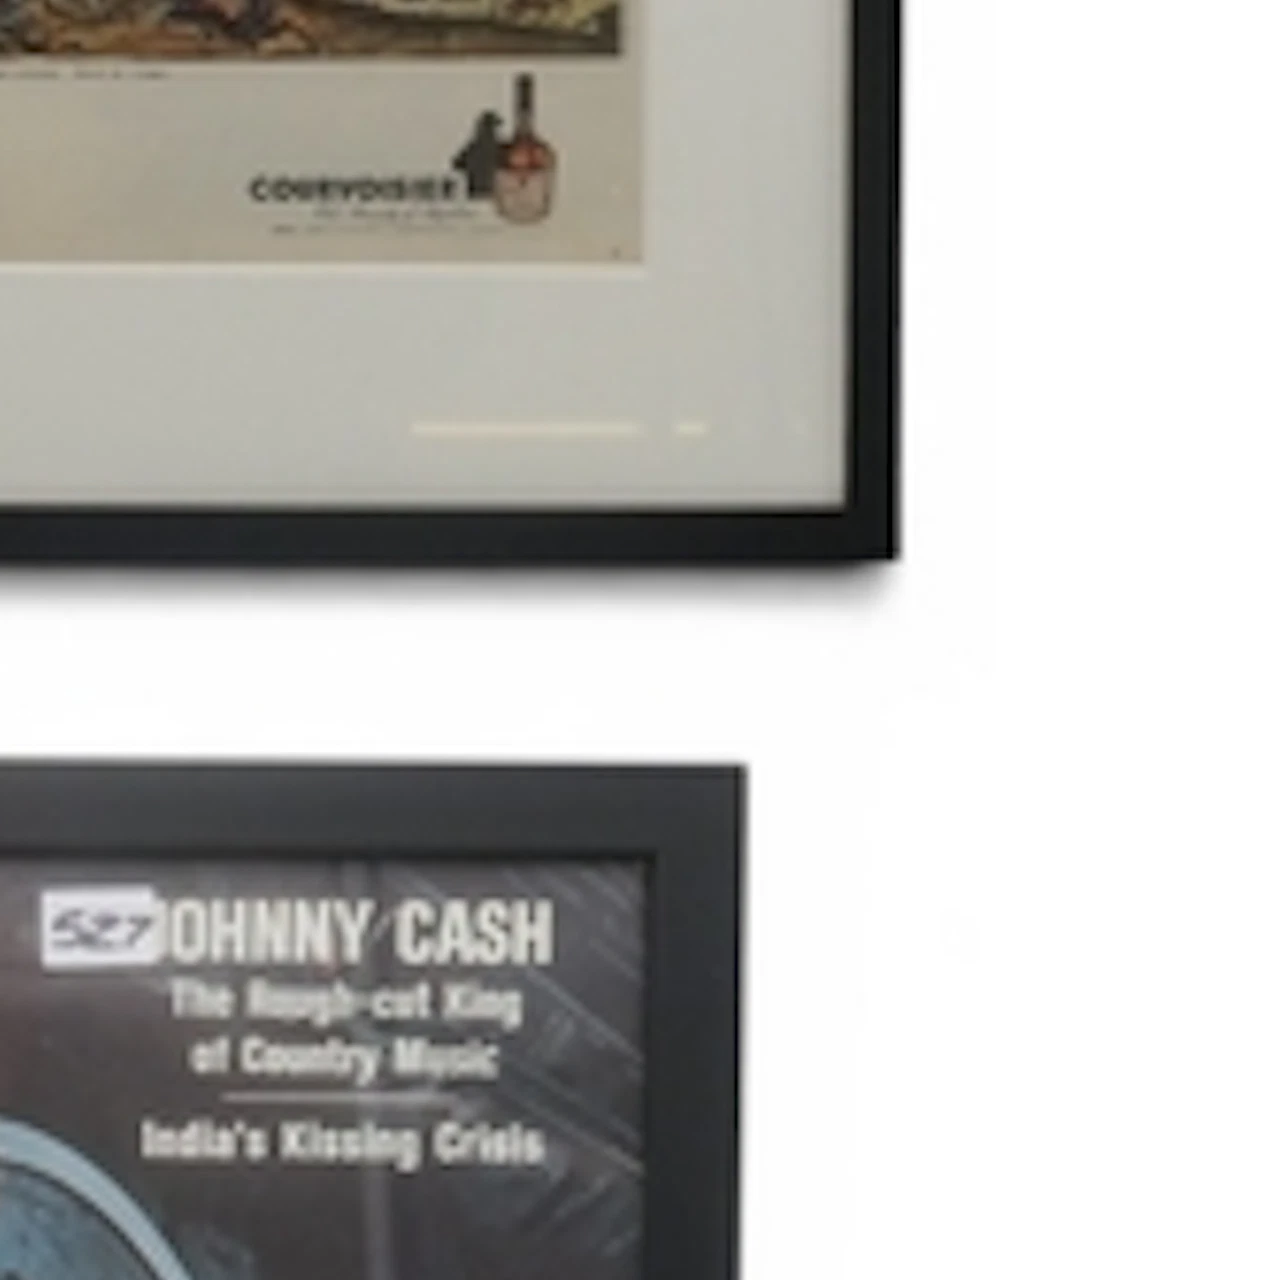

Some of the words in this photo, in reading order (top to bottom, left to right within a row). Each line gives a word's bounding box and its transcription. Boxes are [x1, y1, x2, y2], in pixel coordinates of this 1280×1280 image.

[49, 906, 154, 951] 527
[394, 899, 554, 964] CASH
[170, 976, 235, 1019] The
[246, 976, 433, 1028] Rough-cut
[442, 980, 523, 1030] King
[188, 1037, 230, 1074] of
[240, 1036, 381, 1087] Country
[393, 1038, 500, 1078] Music
[140, 1118, 268, 1160] India's
[279, 1120, 423, 1174] Kissing
[432, 1121, 547, 1164] Crisis
